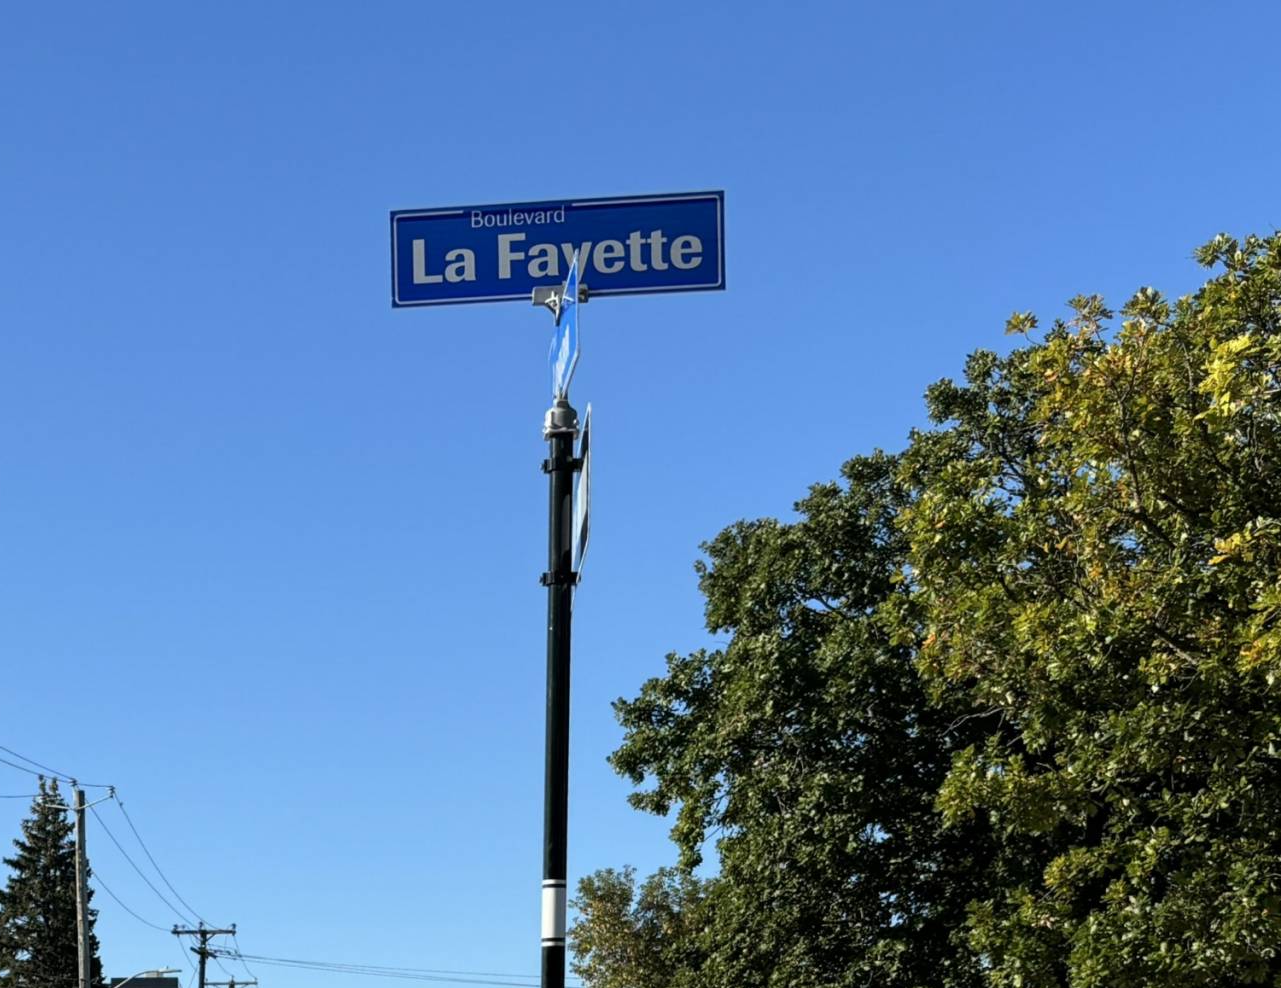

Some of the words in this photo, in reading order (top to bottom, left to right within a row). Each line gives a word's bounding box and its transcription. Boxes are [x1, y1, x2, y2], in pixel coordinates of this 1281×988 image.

[471, 205, 565, 228] Boulevard
[412, 238, 476, 284] La
[497, 230, 703, 284] Fayette
